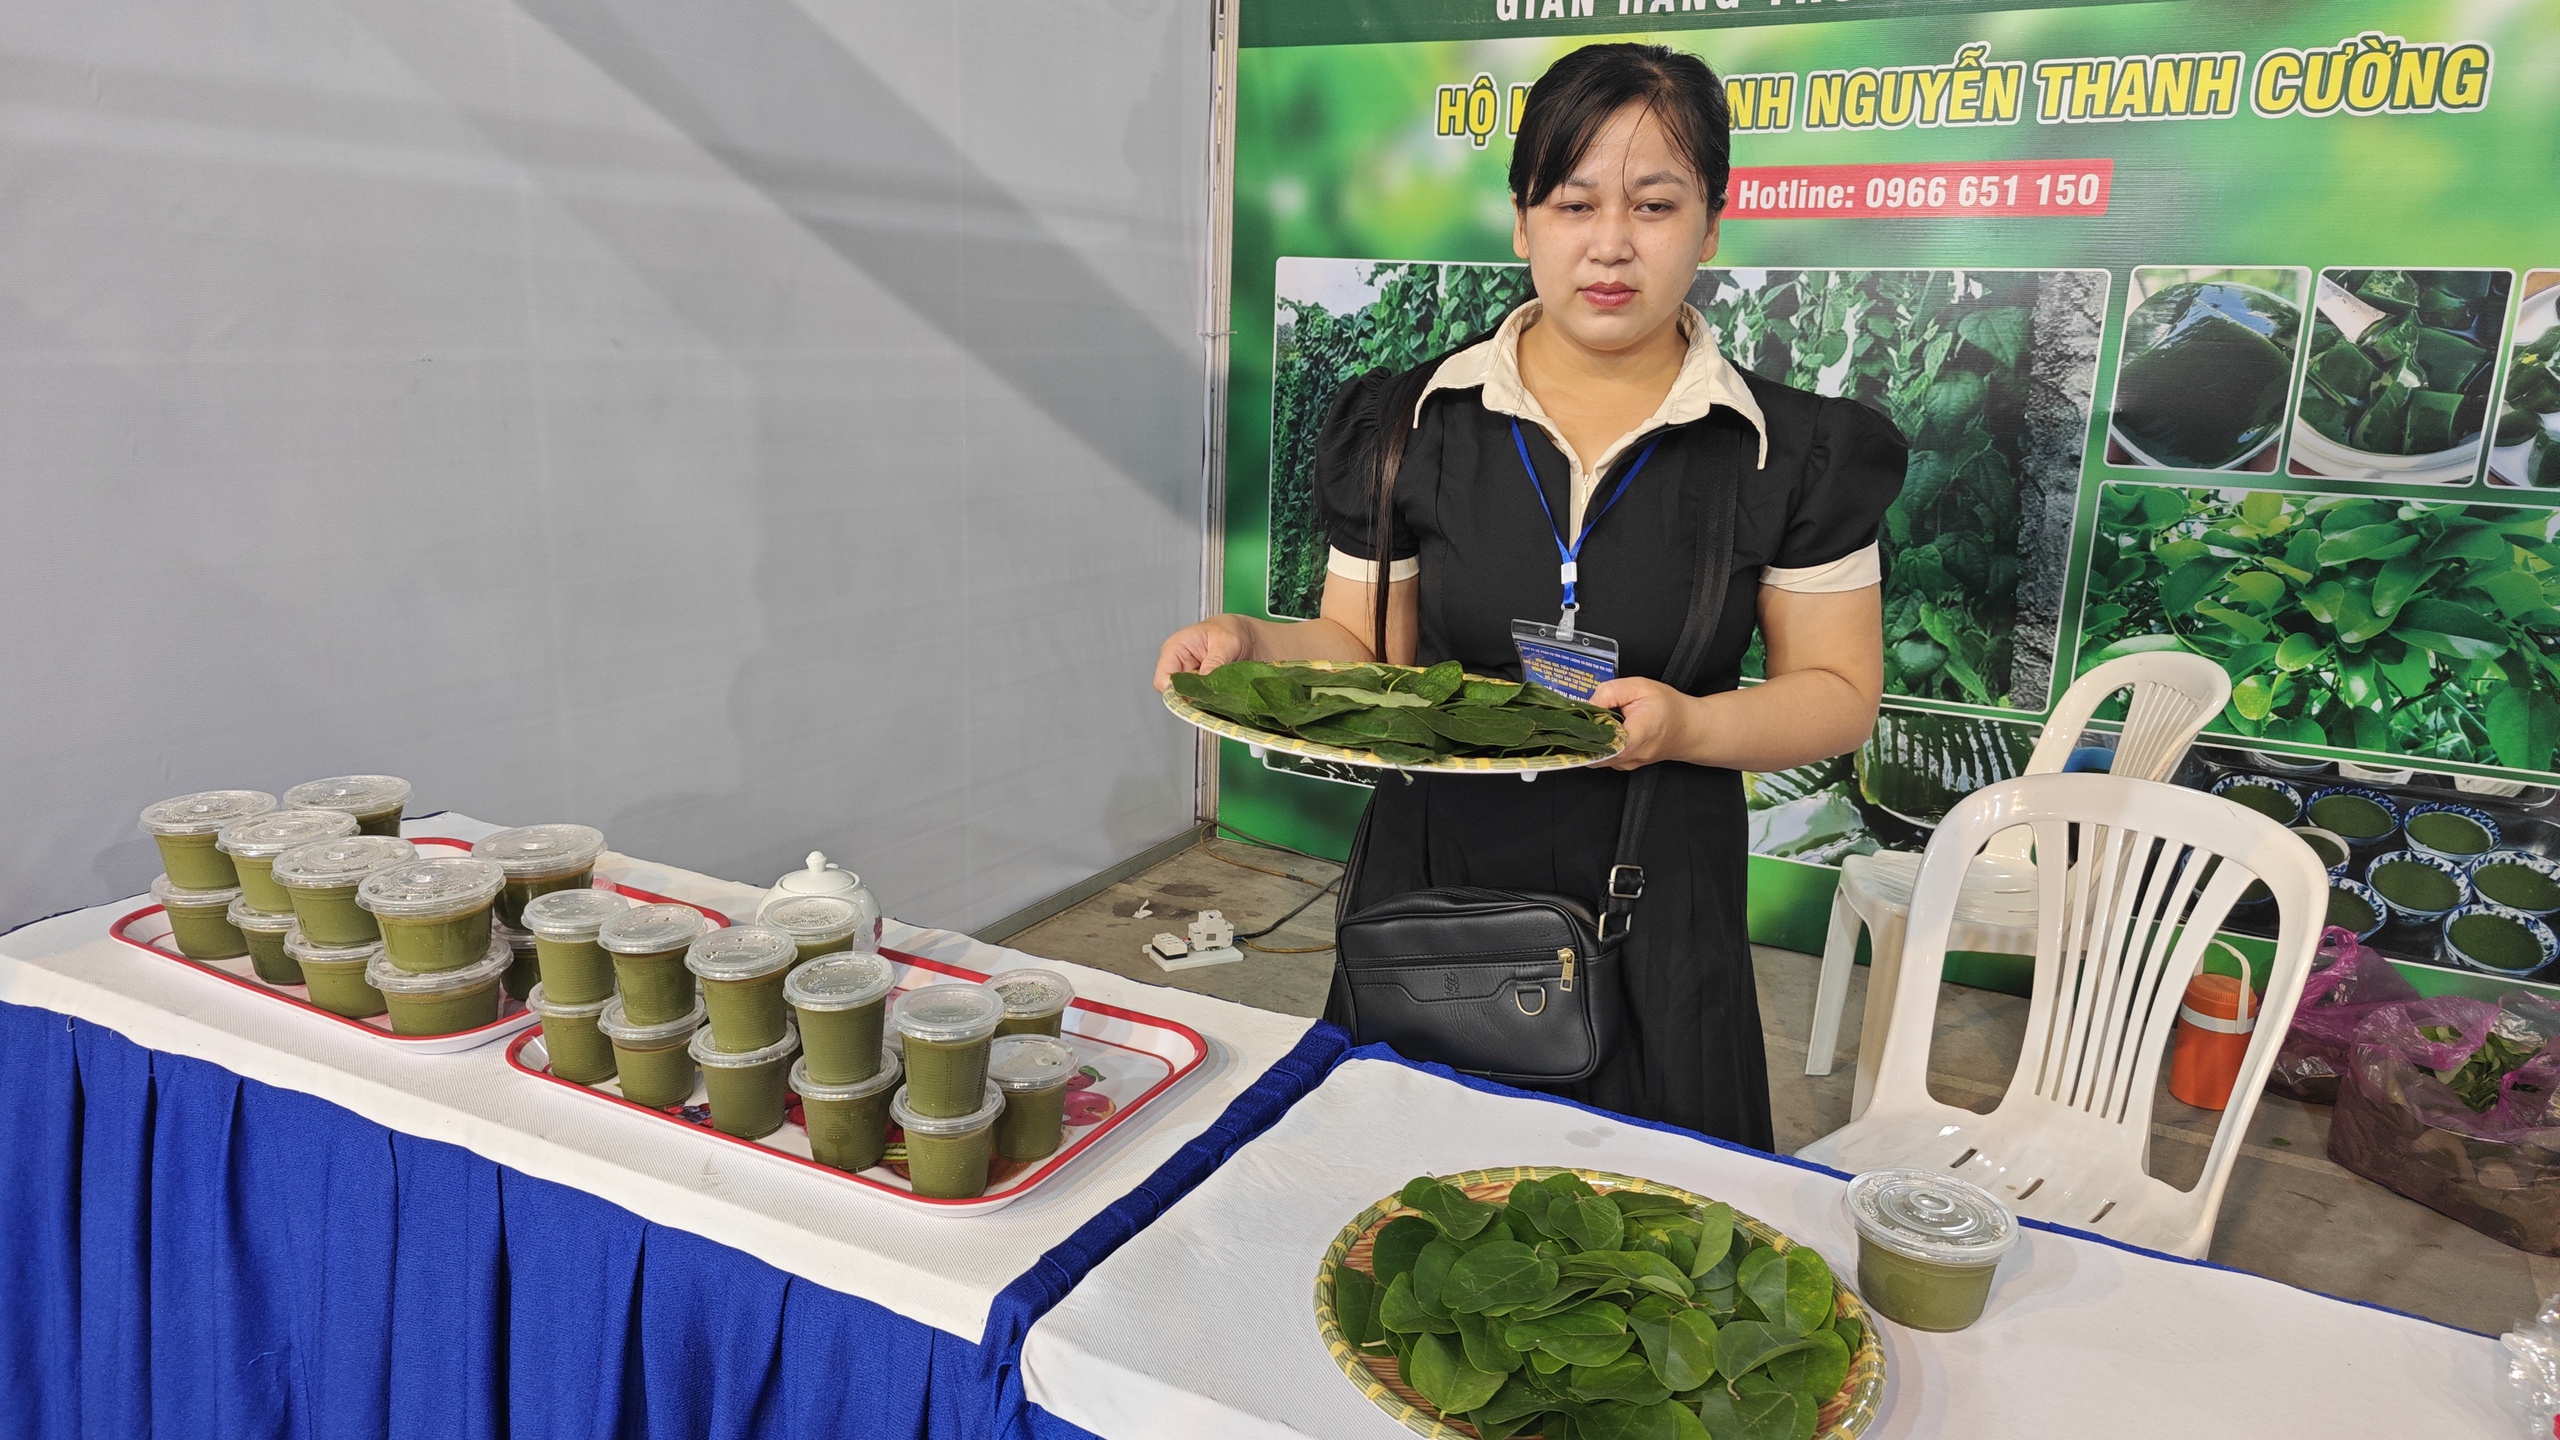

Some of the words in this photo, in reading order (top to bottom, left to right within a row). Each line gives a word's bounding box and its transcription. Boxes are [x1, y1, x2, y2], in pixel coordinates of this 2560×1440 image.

[1437, 75, 1498, 147] HỘ
[1804, 42, 2022, 128] NGUYỄN
[2036, 52, 2242, 122] THANH
[2252, 33, 2491, 116] CƯỜNG
[1737, 179, 1855, 210] Hotline:
[1866, 177, 1947, 209] 0966
[1958, 175, 2018, 207] 651
[2035, 173, 2100, 206] 150
